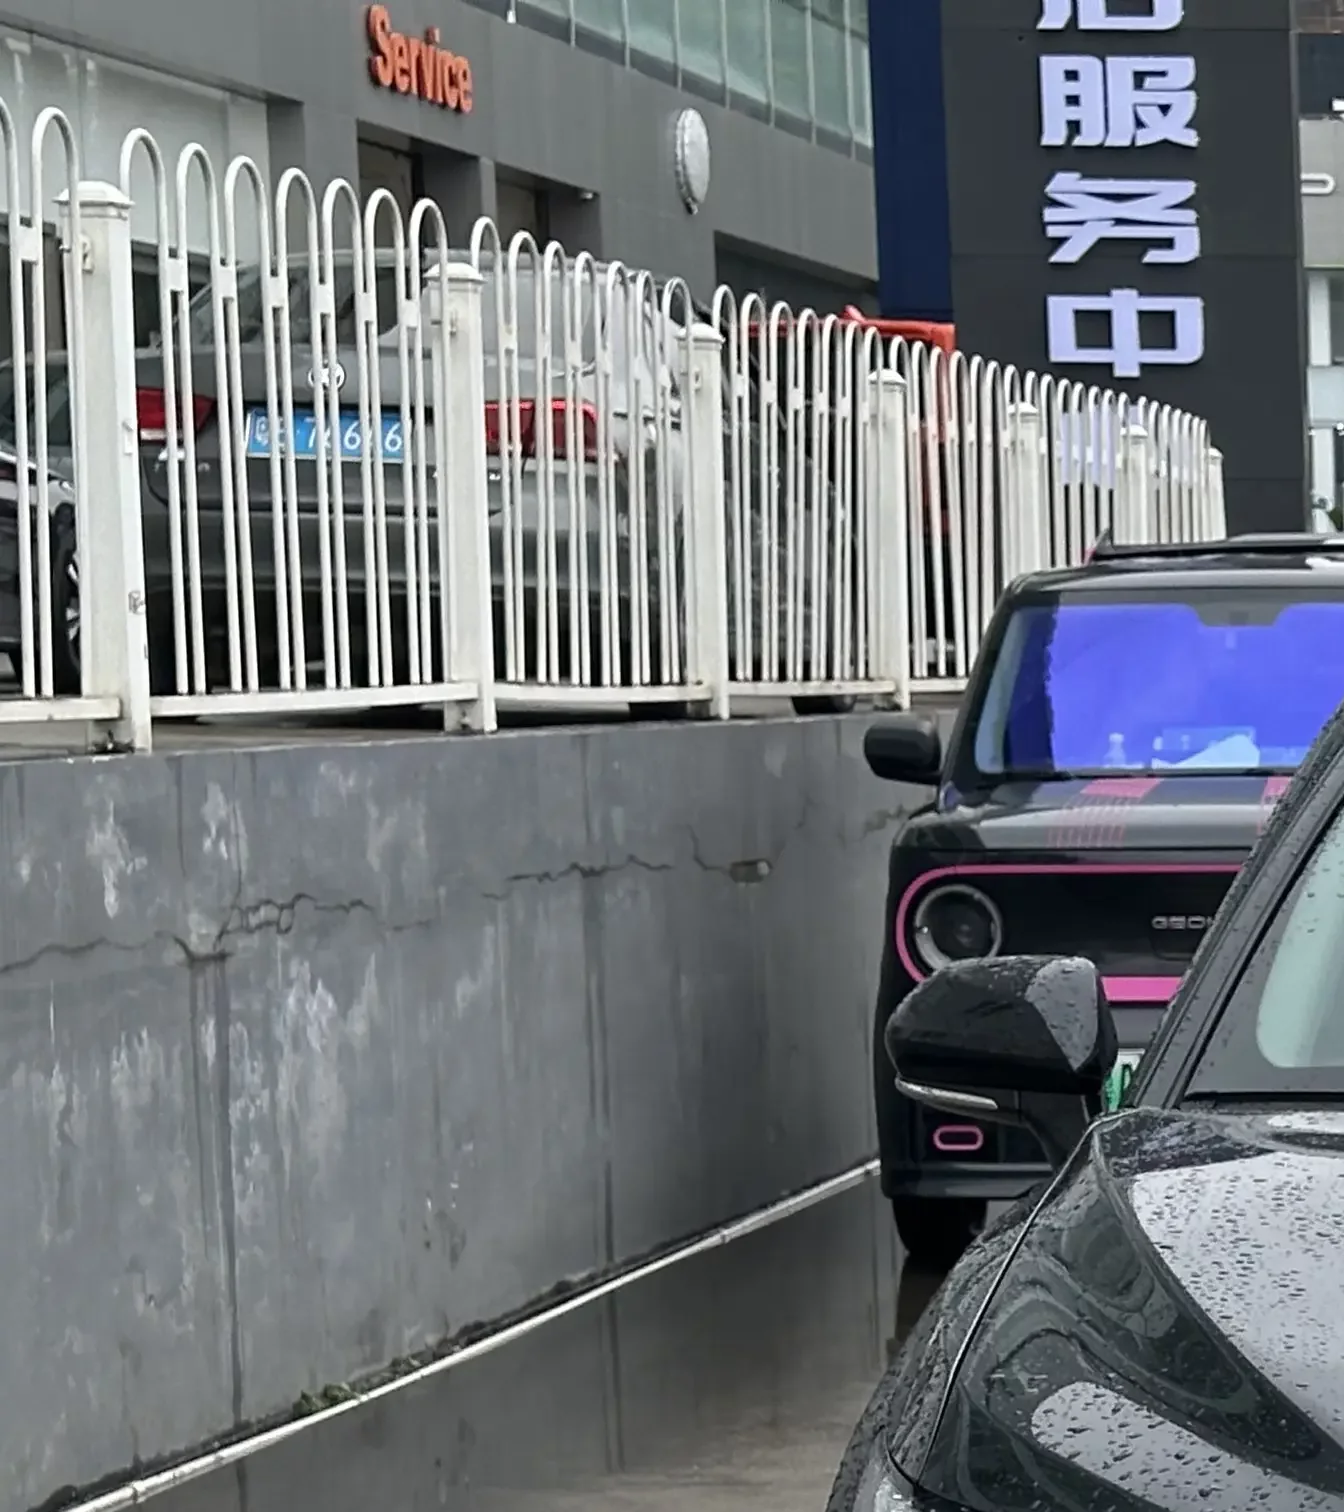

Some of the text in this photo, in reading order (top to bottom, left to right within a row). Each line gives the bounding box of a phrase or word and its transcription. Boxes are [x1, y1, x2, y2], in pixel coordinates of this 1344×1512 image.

[368, 4, 473, 113] Service
[1036, 0, 1206, 488] 服务中
